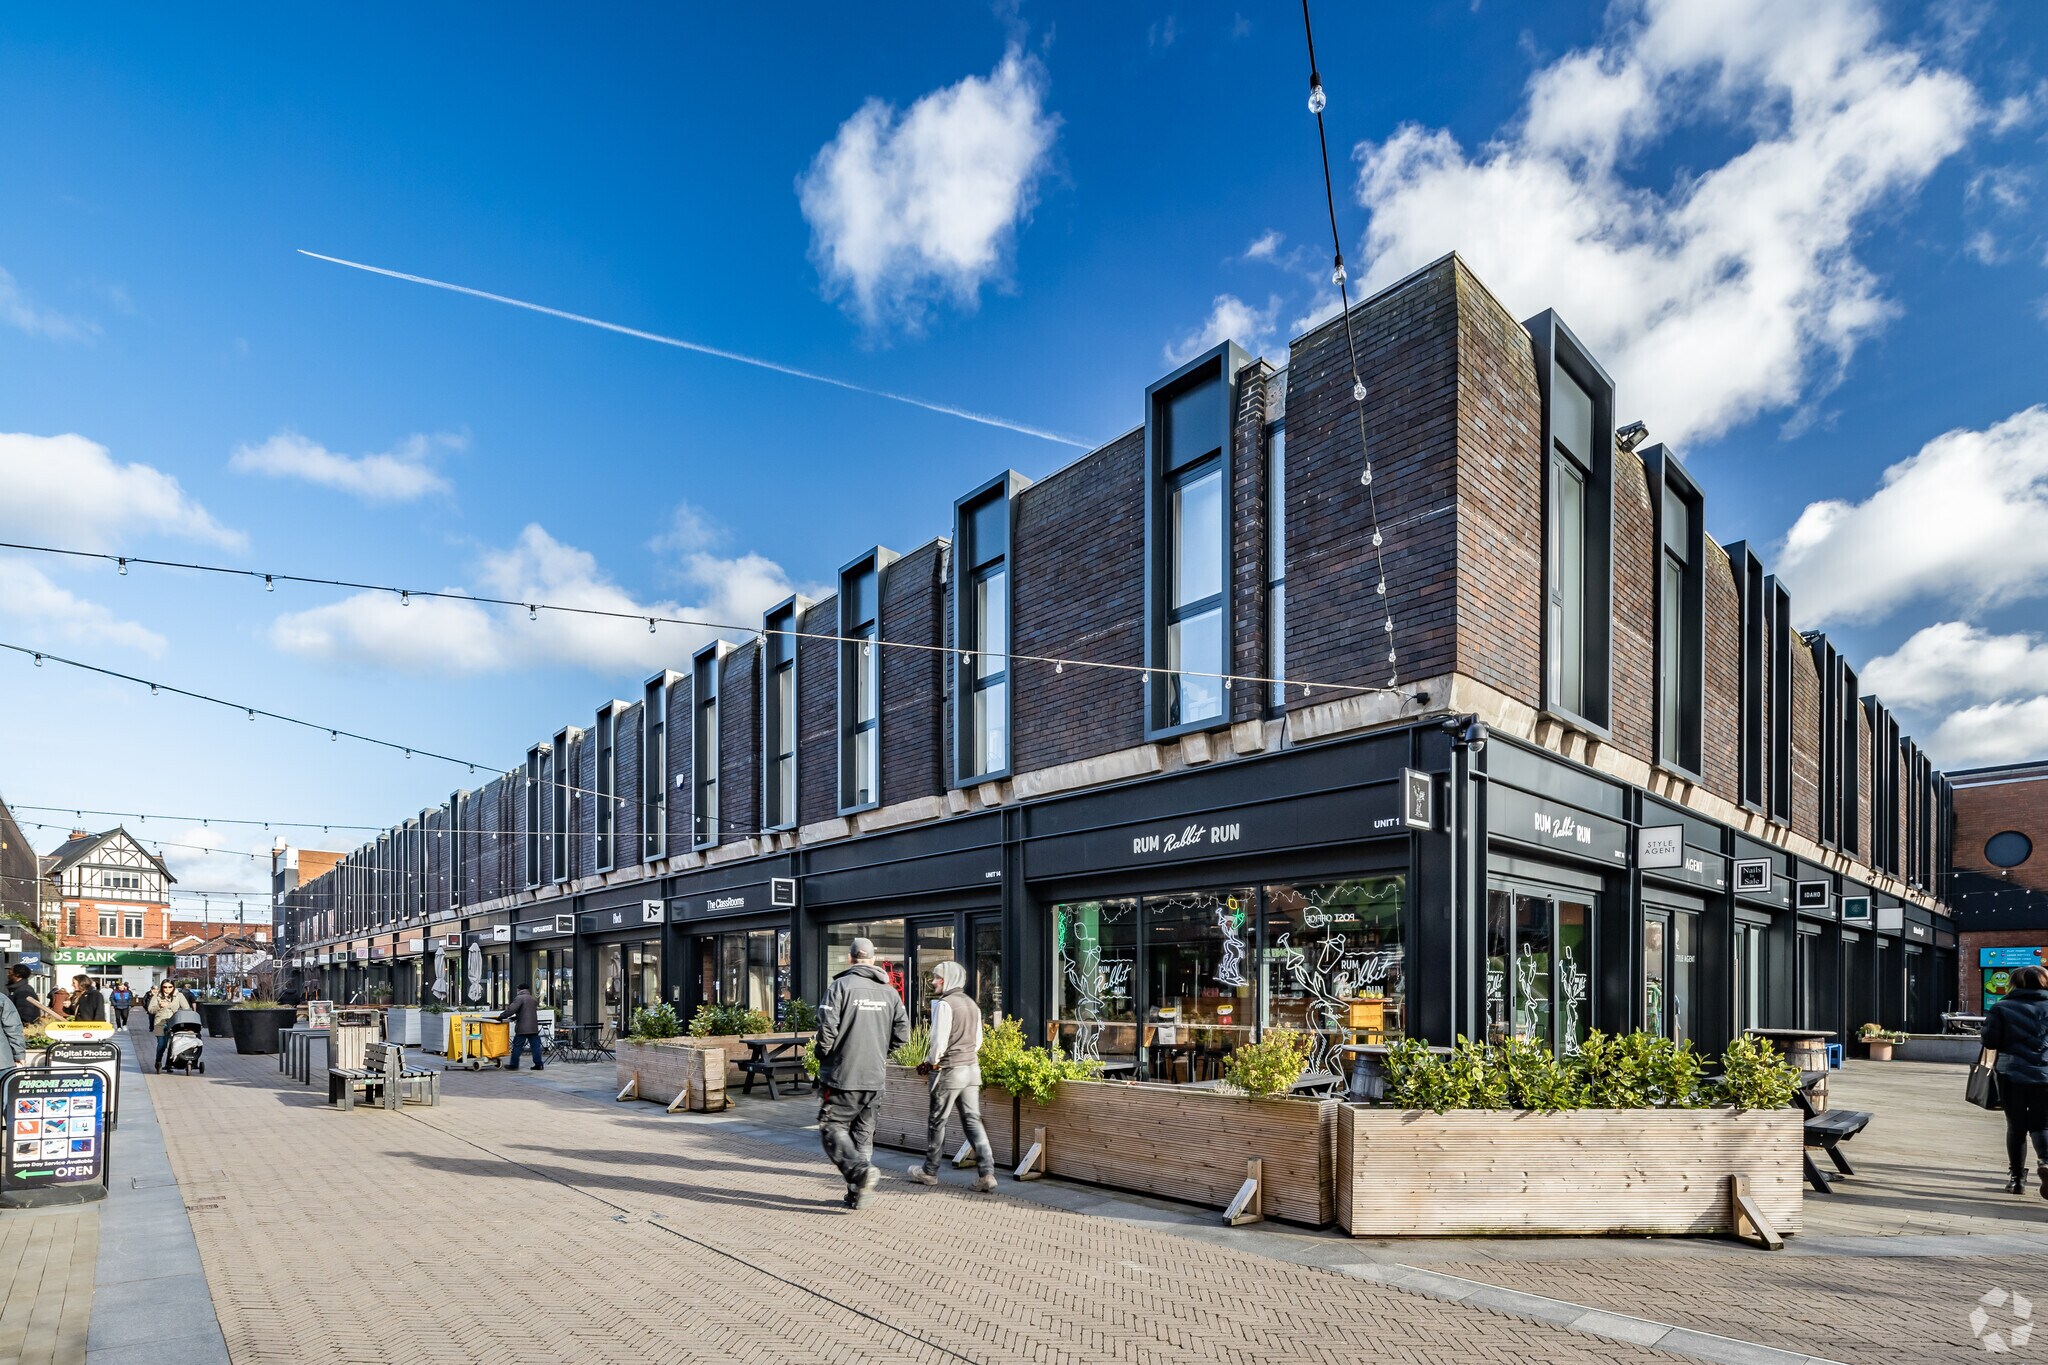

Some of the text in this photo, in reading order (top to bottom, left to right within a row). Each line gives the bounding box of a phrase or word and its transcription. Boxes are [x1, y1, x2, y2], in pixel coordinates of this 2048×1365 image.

[1374, 818, 1395, 828] UNIT
[1534, 813, 1591, 844] RUM Rabbit RUN
[1133, 823, 1240, 854] RUM Rabbit RUN
[1647, 840, 1673, 848] STYLE
[1644, 847, 1676, 855] AGENT
[1685, 858, 1703, 873] AGENT
[707, 900, 715, 909] The
[76, 952, 117, 962] BANK
[1341, 959, 1359, 969] RUM
[1094, 963, 1132, 996] Rabbit
[1333, 956, 1394, 996] Rabbit
[1114, 986, 1126, 994] RUN
[54, 1050, 82, 1058] Digital
[18, 1079, 94, 1089] PHONE ZONE
[55, 1165, 93, 1177] OPEN
